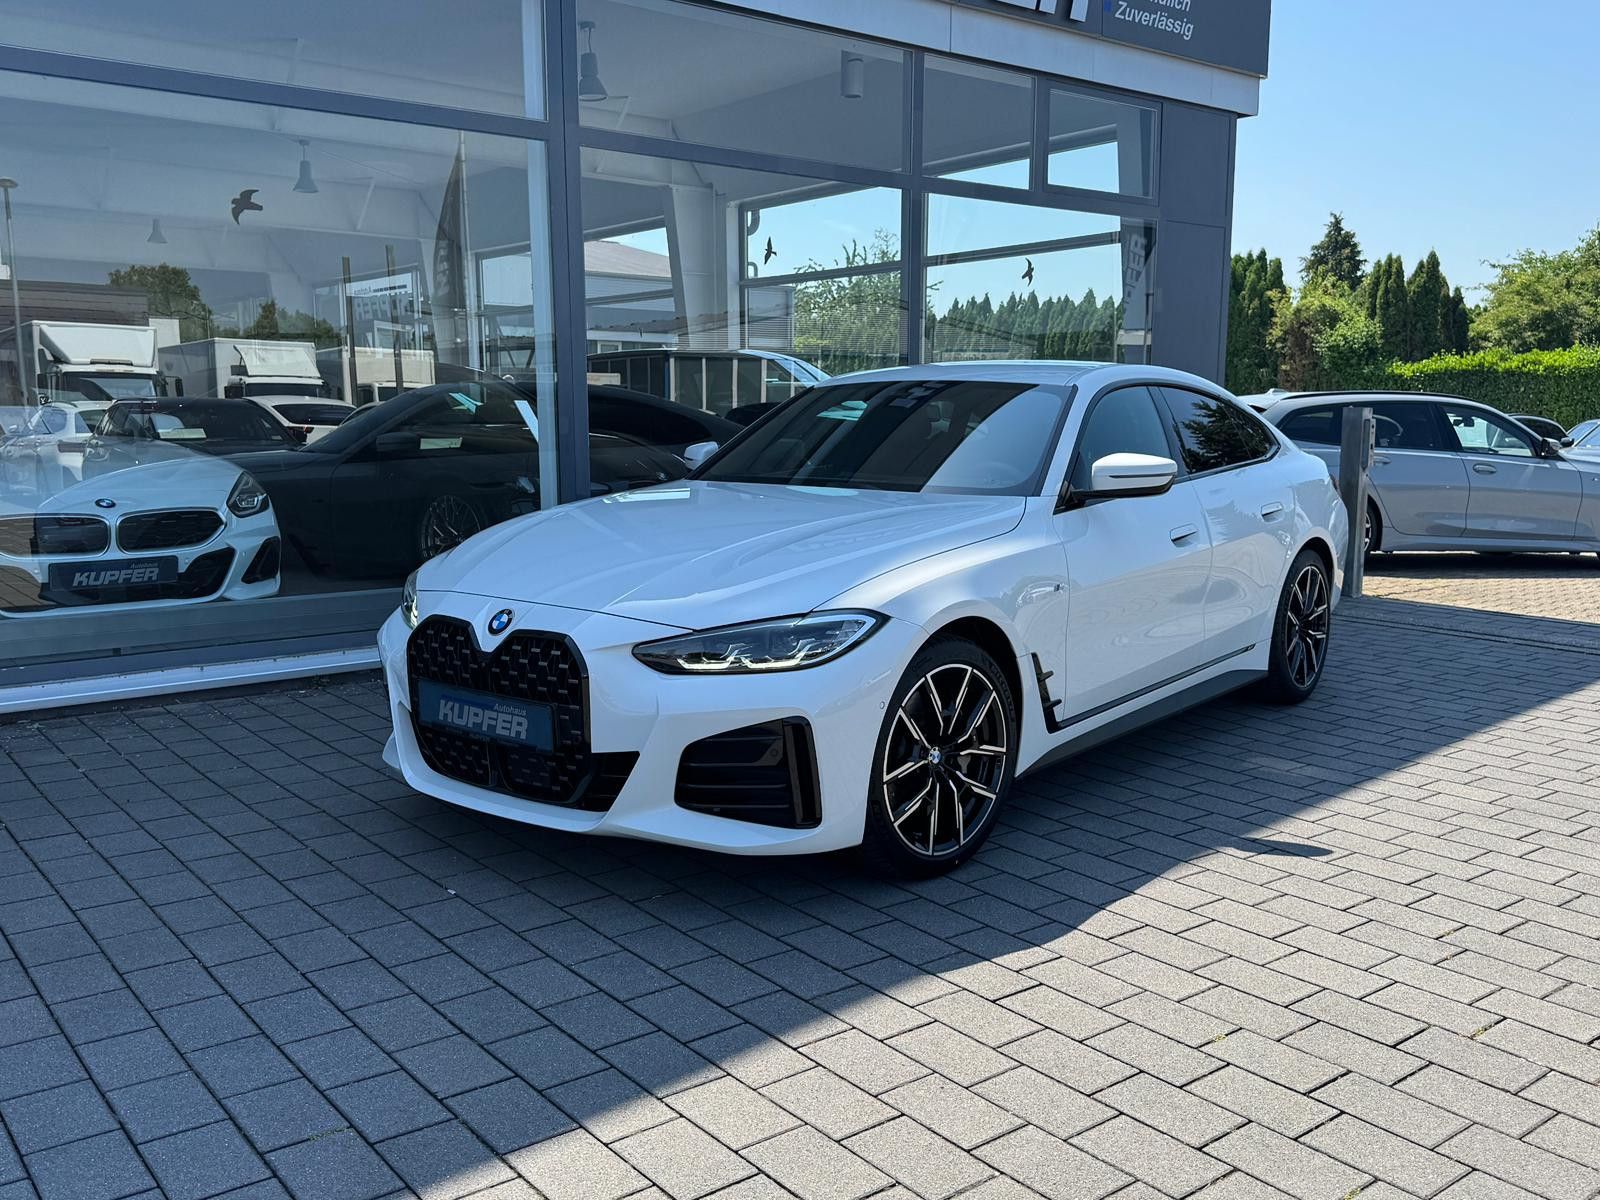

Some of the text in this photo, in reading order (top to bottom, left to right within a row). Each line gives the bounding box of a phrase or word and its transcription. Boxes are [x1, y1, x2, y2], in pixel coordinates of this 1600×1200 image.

[1115, 1, 1194, 40] Zuverlässig
[72, 568, 159, 587] KUPFER
[439, 700, 528, 739] KUPFER
[494, 703, 526, 715] Autohaus
